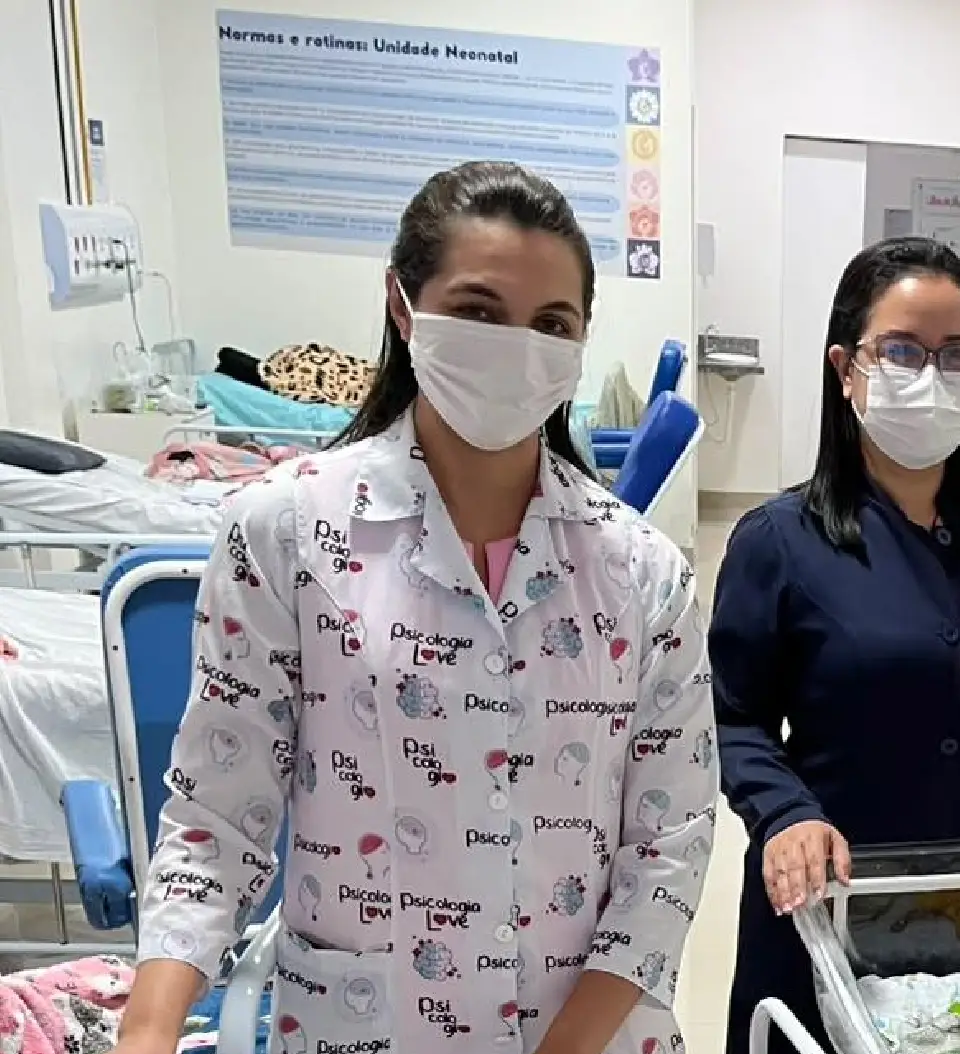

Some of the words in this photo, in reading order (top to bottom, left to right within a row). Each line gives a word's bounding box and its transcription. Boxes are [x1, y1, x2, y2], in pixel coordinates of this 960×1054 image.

[219, 26, 284, 44] Normas
[290, 35, 299, 46] e
[374, 38, 439, 57] Unidade
[446, 43, 518, 64] Neonatal
[390, 623, 474, 649] Psicologia
[400, 891, 481, 915] Psicologia
